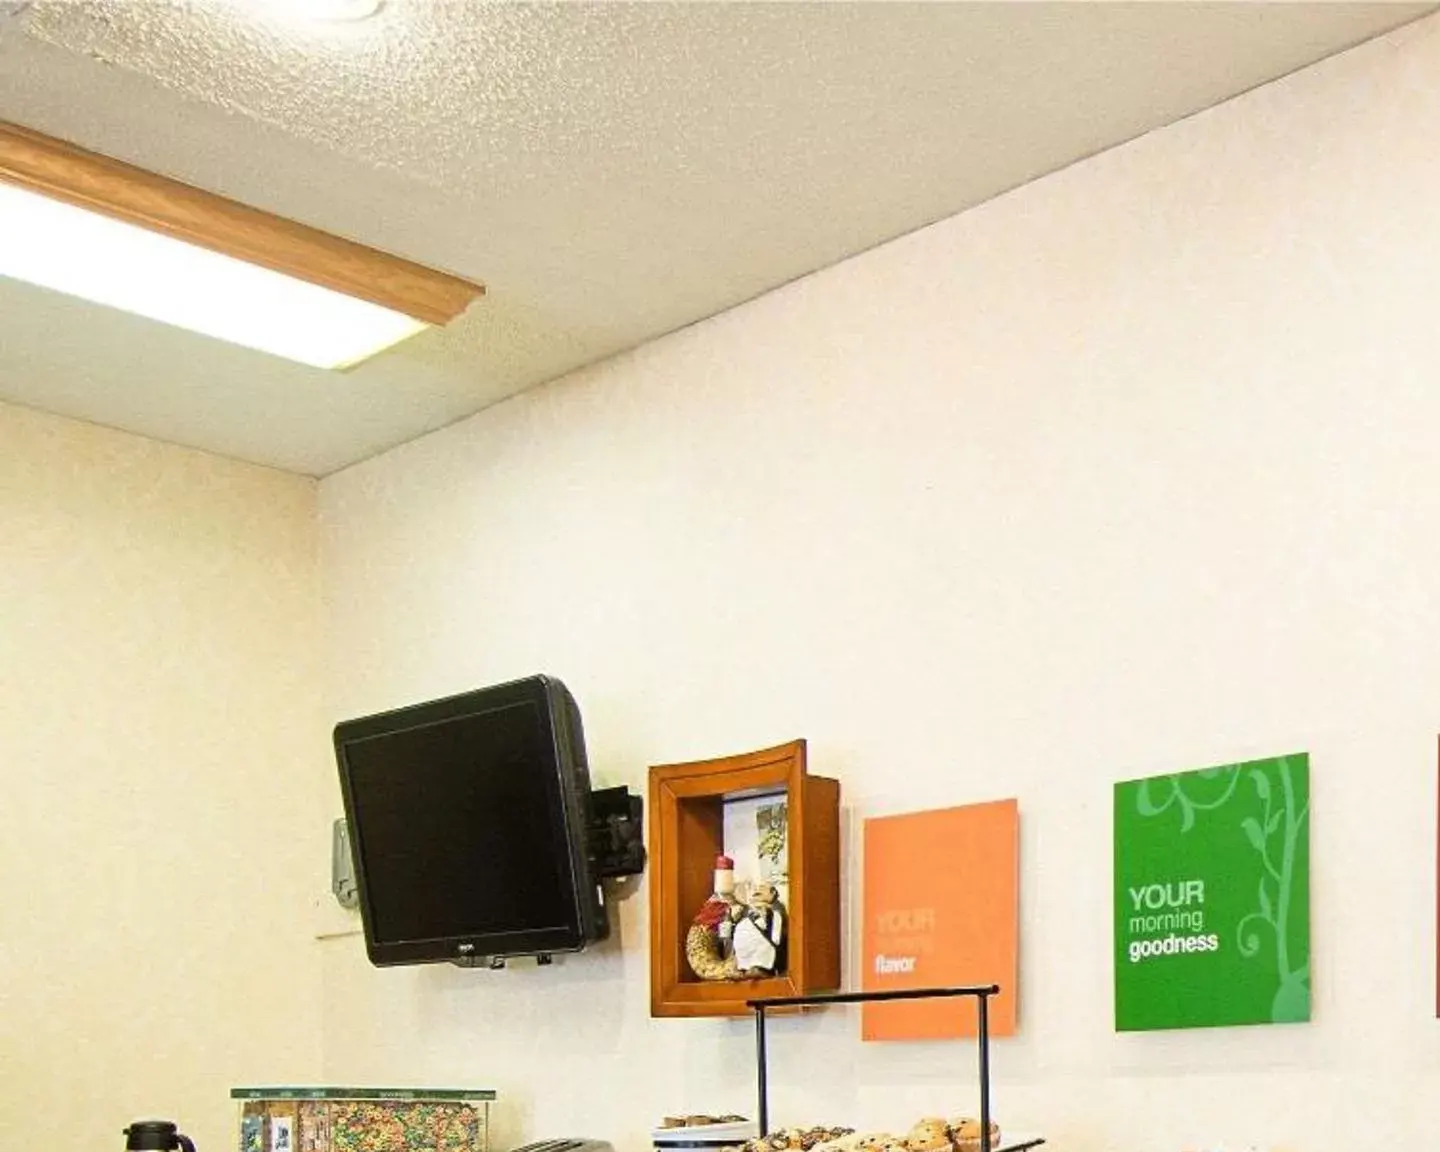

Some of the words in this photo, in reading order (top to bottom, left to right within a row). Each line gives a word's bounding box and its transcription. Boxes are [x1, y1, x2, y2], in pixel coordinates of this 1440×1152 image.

[1128, 880, 1204, 911] YOUR
[1129, 907, 1203, 932] morning
[1129, 932, 1219, 962] goodness
[875, 954, 917, 974] flavor
